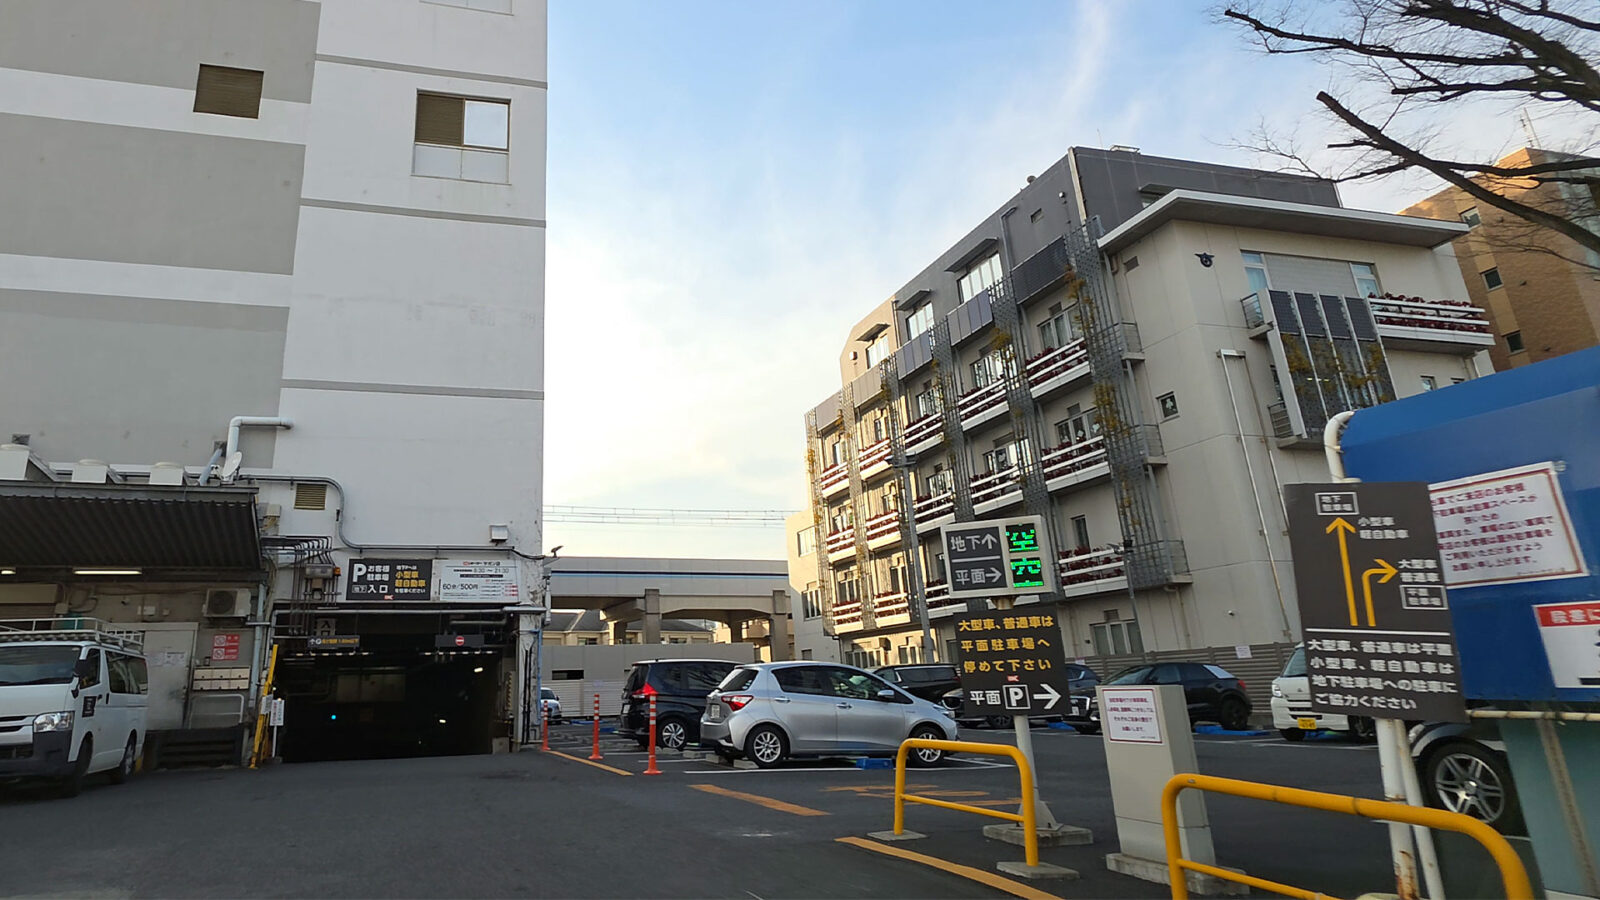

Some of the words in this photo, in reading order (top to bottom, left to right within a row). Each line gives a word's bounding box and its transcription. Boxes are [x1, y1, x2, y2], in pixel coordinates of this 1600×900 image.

[1320, 495, 1342, 504] 地下
[1321, 503, 1354, 512] 駐車場
[1357, 516, 1396, 527] 小型車
[1359, 529, 1410, 540] 軽自動車
[950, 535, 981, 552] 地下
[367, 565, 390, 573] お客様
[1398, 558, 1438, 569] 大型車
[352, 563, 367, 583] P
[366, 573, 390, 581] 駐車場
[395, 570, 419, 579] 小型車
[954, 568, 986, 585] 平面
[1401, 572, 1441, 583] 普通車
[394, 579, 426, 587] 軽自動車
[367, 584, 389, 594] 入口
[1406, 588, 1429, 596] 平面
[1408, 597, 1442, 606] 駐車場
[958, 616, 1054, 632] 大型車、普通車は
[960, 637, 1051, 653] 平面駐車場へ
[1307, 639, 1453, 657] 大型車、普通車は平面
[963, 659, 1052, 673] 停めて下さい
[1310, 656, 1455, 675] 小型車、軽自動車は
[1311, 674, 1459, 693] 地下駐車場への駐車に
[969, 690, 1001, 706] 平面
[1008, 687, 1024, 707] P
[1314, 692, 1417, 710] ご協力ください
